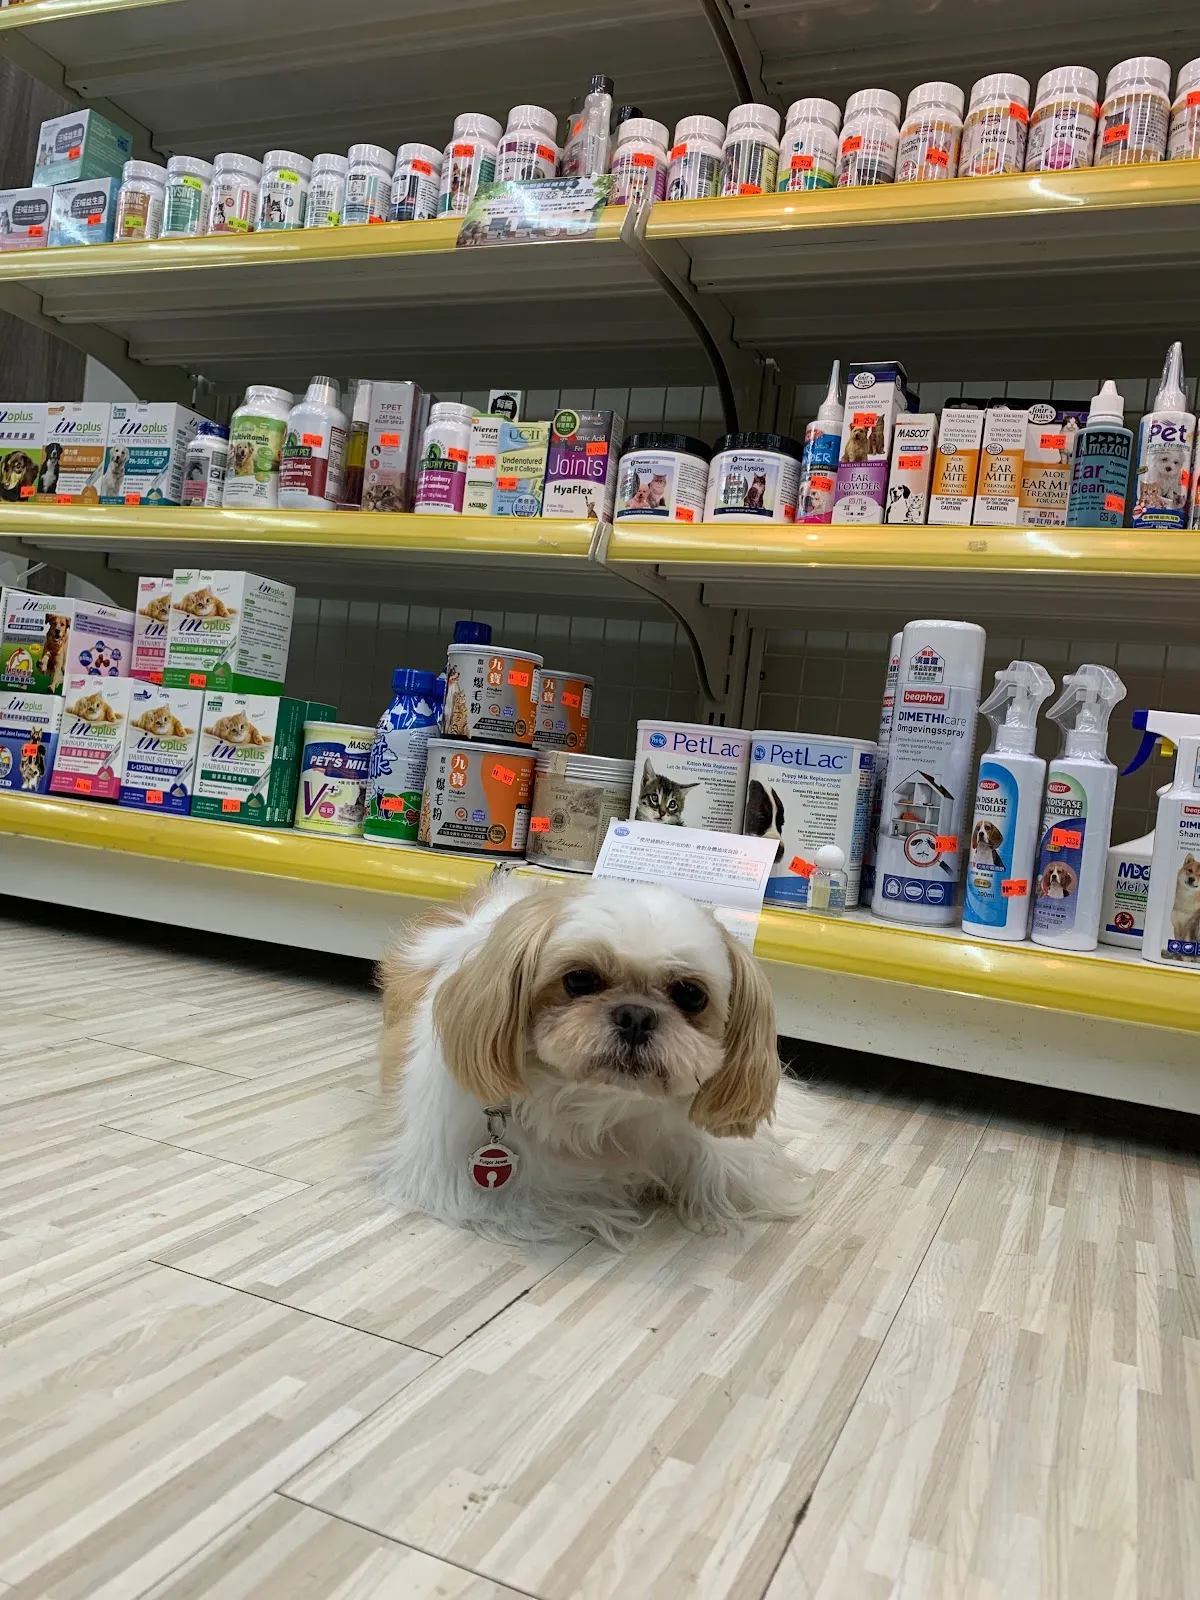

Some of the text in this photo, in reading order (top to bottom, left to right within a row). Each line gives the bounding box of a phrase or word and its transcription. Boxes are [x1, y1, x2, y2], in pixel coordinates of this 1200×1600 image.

[380, 403, 403, 411] T-PET
[472, 425, 499, 434] Nieren
[897, 428, 930, 438] MASCOT
[1147, 423, 1188, 444] Pet
[444, 462, 456, 470] PET
[502, 457, 543, 465] Undenatured
[549, 454, 604, 477] Joints
[500, 465, 513, 473] Type
[518, 465, 543, 473] Collagen
[744, 464, 765, 473] Lysine
[945, 462, 964, 473] EAR
[990, 462, 1009, 473] EAR
[1072, 461, 1105, 481] Ear
[850, 473, 869, 482] EAR
[941, 473, 968, 482] MITE
[985, 472, 1016, 482] MITE
[1041, 470, 1065, 478] ALOE
[837, 481, 881, 491] POWDER
[1022, 478, 1046, 489] EAR
[1071, 482, 1105, 495] Clean
[553, 485, 593, 496] HyaFlex
[174, 614, 231, 633] inoplus
[170, 636, 230, 646] DIGESTIVE SUPPORT
[489, 658, 503, 685] 九寶
[904, 691, 943, 703] beaphar
[898, 711, 967, 727] DIMETHIcare
[66, 718, 117, 736] inoplus
[897, 724, 965, 739] Omgevingsspray
[87, 741, 114, 750] SUPPORT
[134, 732, 188, 751] inoplus
[673, 732, 740, 758] PetLac
[207, 740, 265, 760] inoplus
[322, 750, 341, 758] USA
[128, 754, 187, 767] IMMUNE SUPPORT
[771, 744, 840, 770] PetLac
[131, 764, 154, 772] L-LYSINE
[310, 755, 369, 771] PET'S MIL
[202, 763, 262, 776] HAIRBALL SUPPORT
[451, 755, 467, 787] 九寶
[782, 772, 797, 780] Puppy
[433, 777, 446, 822] 爆毛粉
[981, 796, 1008, 806] DISEASE
[1051, 799, 1082, 809] DISEASE
[1116, 880, 1139, 892] Mei
[977, 890, 995, 899] 200ml
